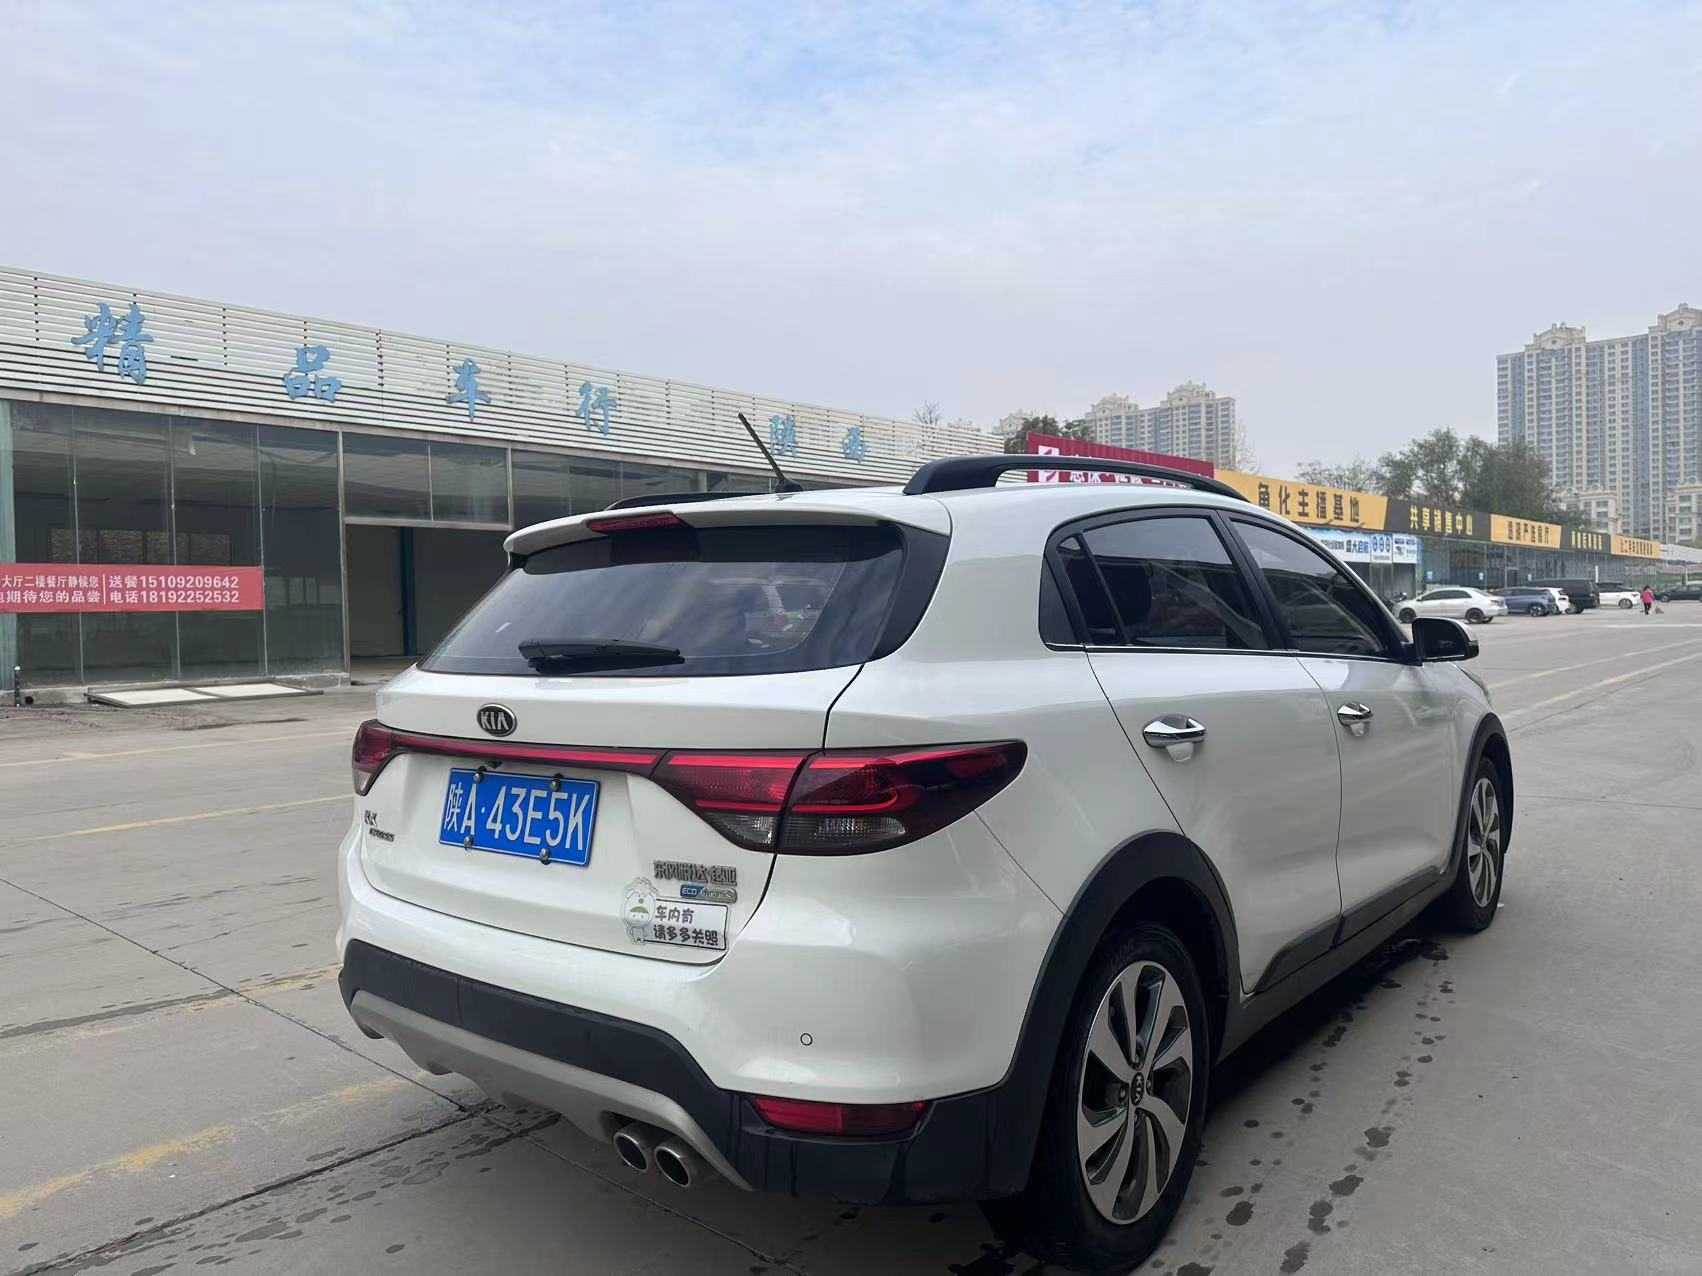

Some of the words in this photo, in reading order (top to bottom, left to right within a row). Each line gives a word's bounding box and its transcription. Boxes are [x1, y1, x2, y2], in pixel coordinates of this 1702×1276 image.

[72, 302, 618, 435] 精品车行
[480, 710, 508, 730] KIA
